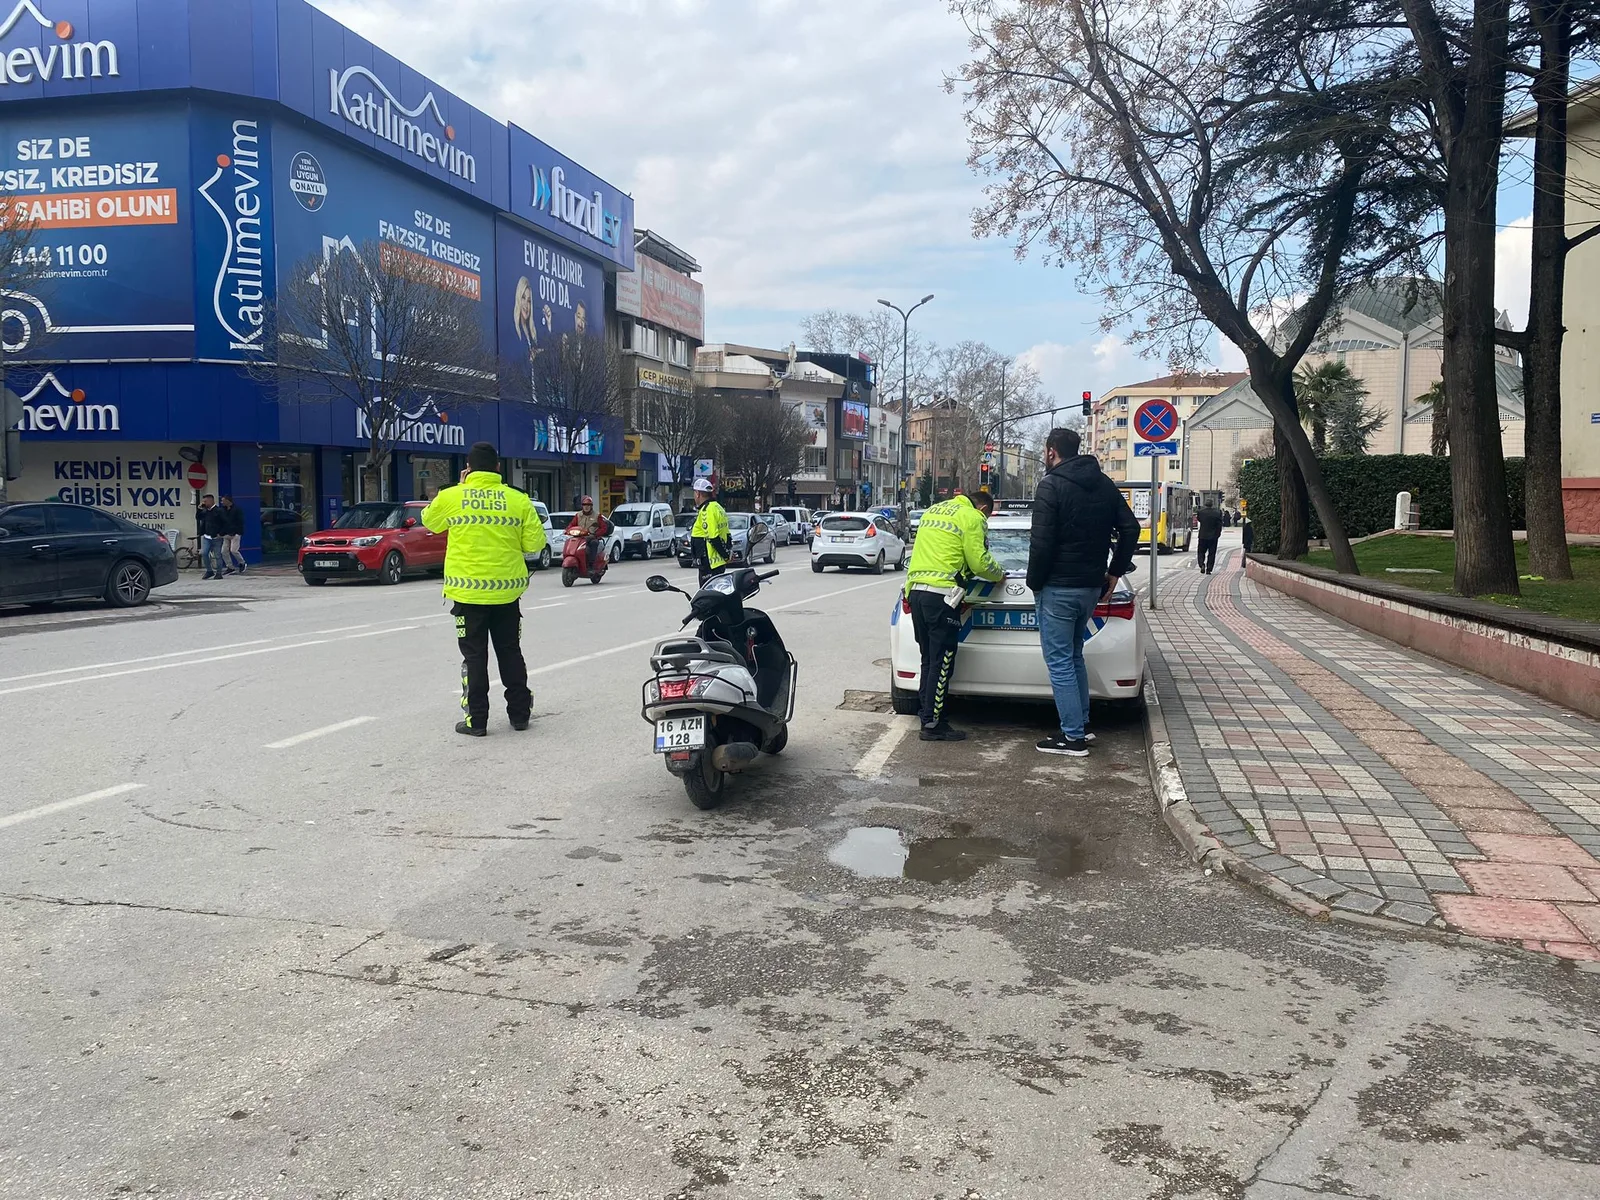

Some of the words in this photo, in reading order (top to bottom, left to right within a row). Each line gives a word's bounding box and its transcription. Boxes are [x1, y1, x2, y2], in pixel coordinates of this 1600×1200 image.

[59, 136, 91, 158] DE
[296, 170, 318, 181] UYGUN
[295, 182, 322, 193] ONAYLI
[96, 195, 170, 219] OLUN!
[435, 218, 451, 239] DE
[524, 239, 535, 267] EV
[537, 245, 549, 273] DE
[539, 274, 556, 303] OTO
[558, 281, 572, 309] DA.
[643, 370, 656, 380] CEP
[54, 457, 121, 480] KENDİ
[128, 456, 182, 480] EVİM
[127, 487, 180, 507] YOK!
[980, 612, 995, 625] 16
[1003, 612, 1011, 625] A
[1020, 612, 1040, 626] 85
[660, 720, 673, 733] 16
[669, 732, 690, 746] 128
